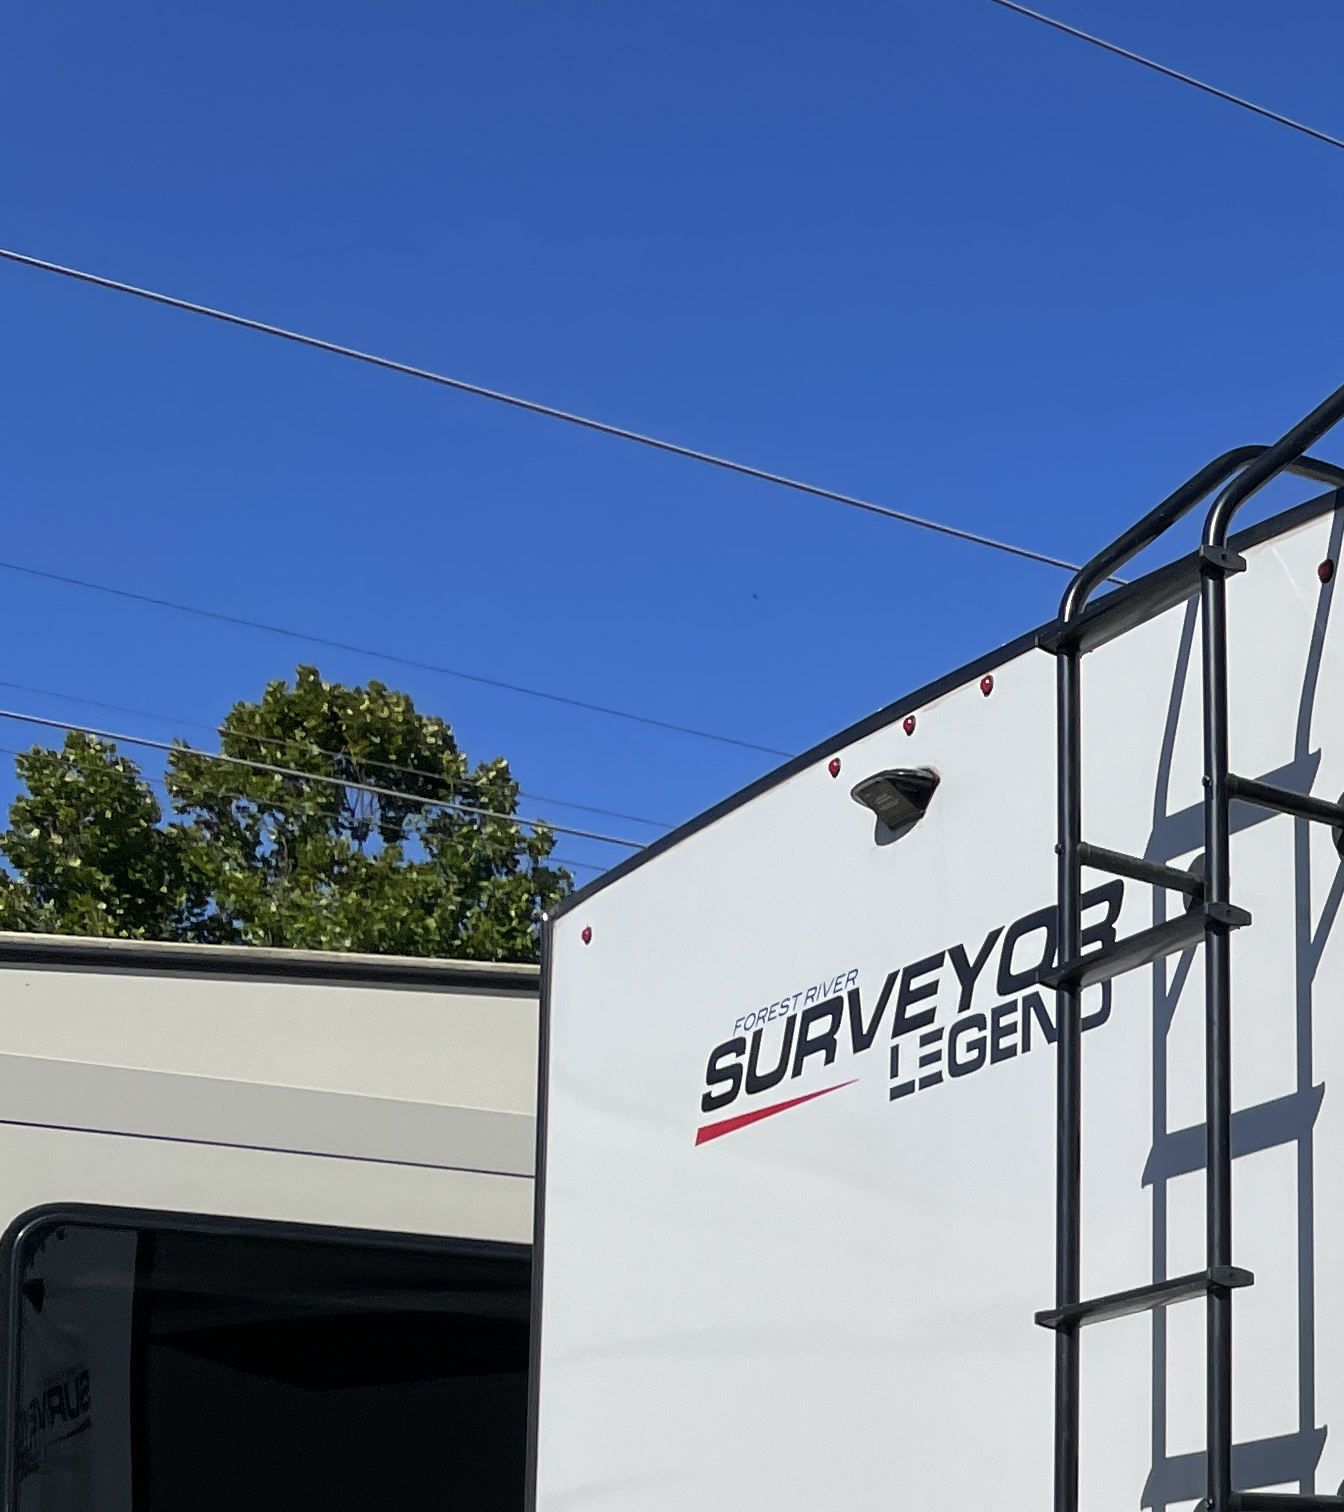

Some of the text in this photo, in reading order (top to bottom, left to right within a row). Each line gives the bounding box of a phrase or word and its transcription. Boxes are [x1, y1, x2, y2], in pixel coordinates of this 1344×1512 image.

[701, 879, 1124, 1113] SURVEYOR
[733, 968, 859, 1035] FOREST RIVER
[889, 977, 1113, 1101] LEGEND
